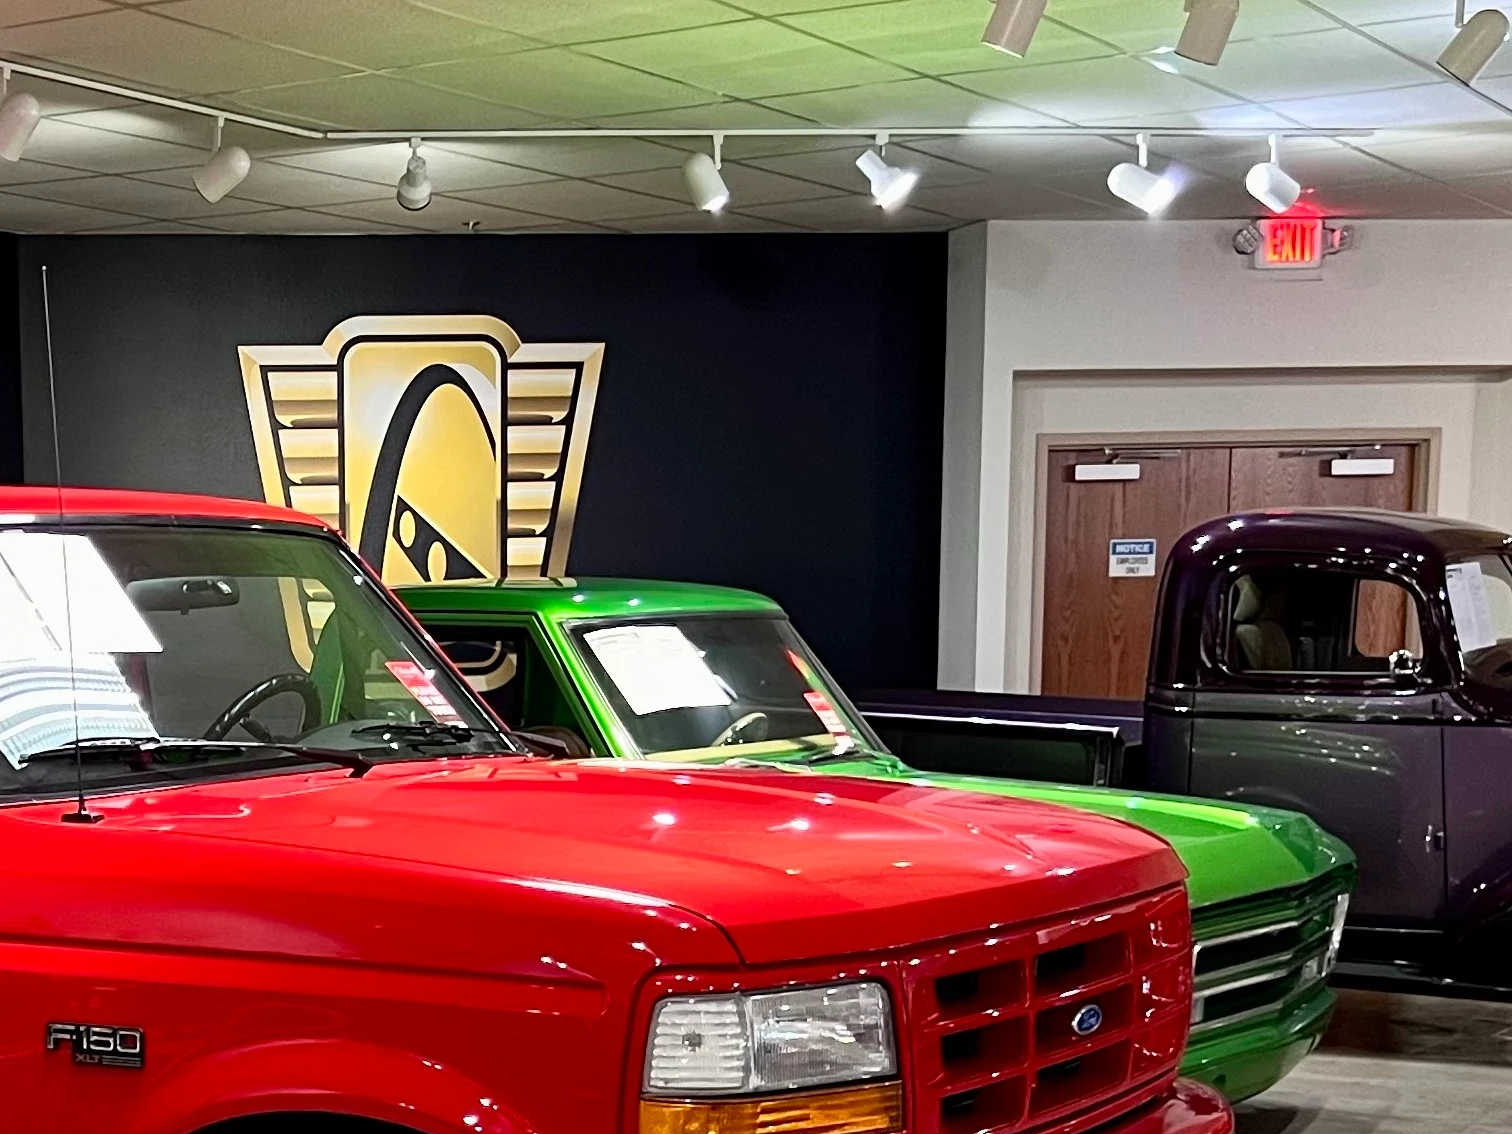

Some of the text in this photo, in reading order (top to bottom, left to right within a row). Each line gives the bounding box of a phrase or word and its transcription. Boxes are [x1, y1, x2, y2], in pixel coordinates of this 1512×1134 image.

[1266, 223, 1317, 263] EXIT
[1115, 543, 1151, 553] NOTICE
[75, 1053, 101, 1063] XLT
